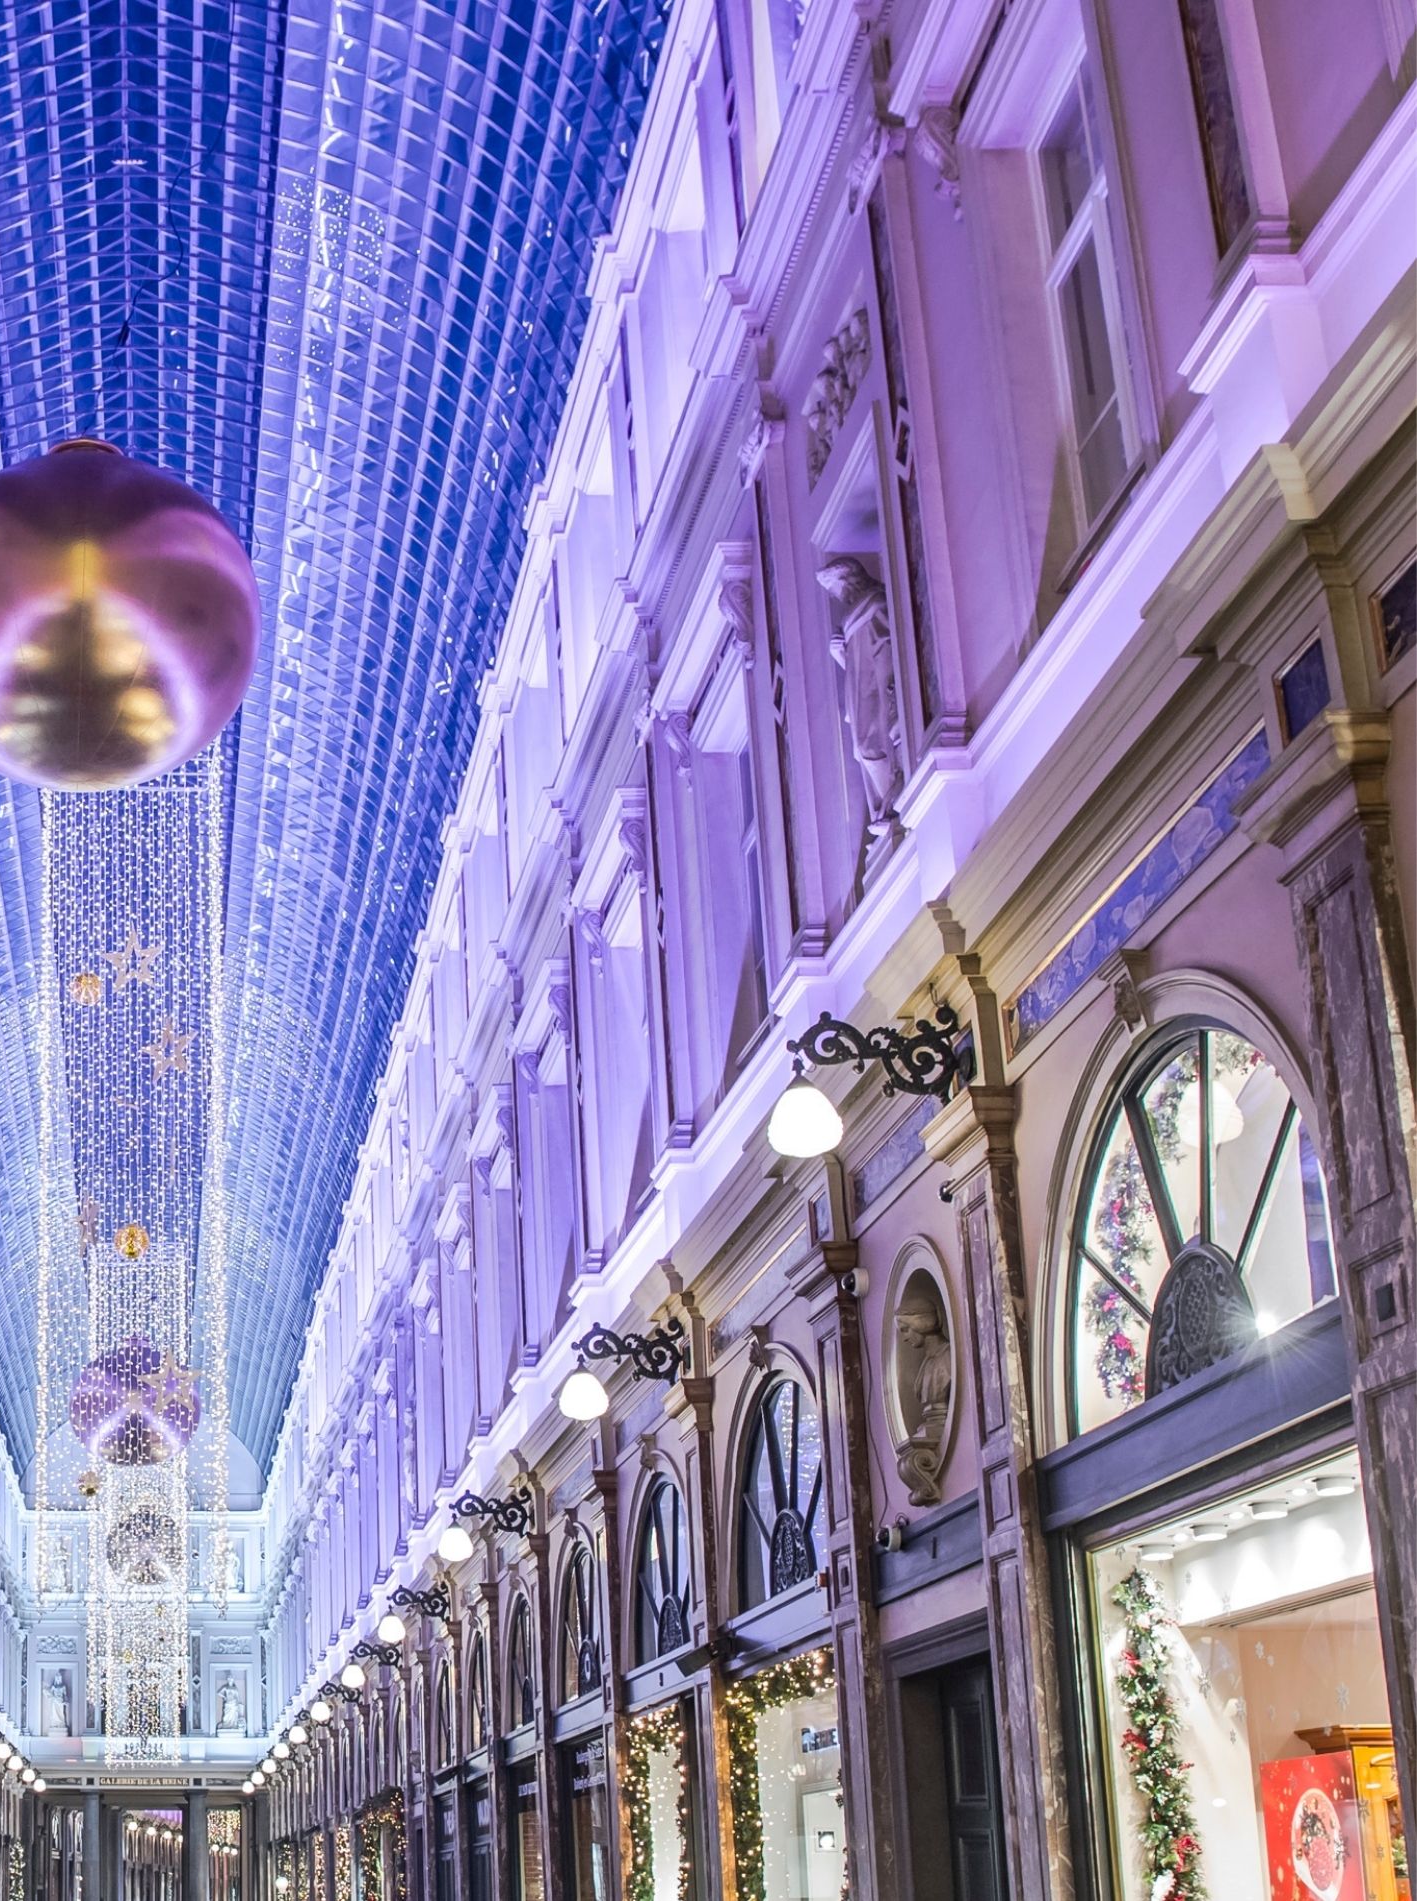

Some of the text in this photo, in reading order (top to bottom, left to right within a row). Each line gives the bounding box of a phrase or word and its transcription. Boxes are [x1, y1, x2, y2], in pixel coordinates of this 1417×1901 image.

[100, 1777, 189, 1786] GALERIE DE LA REINE
